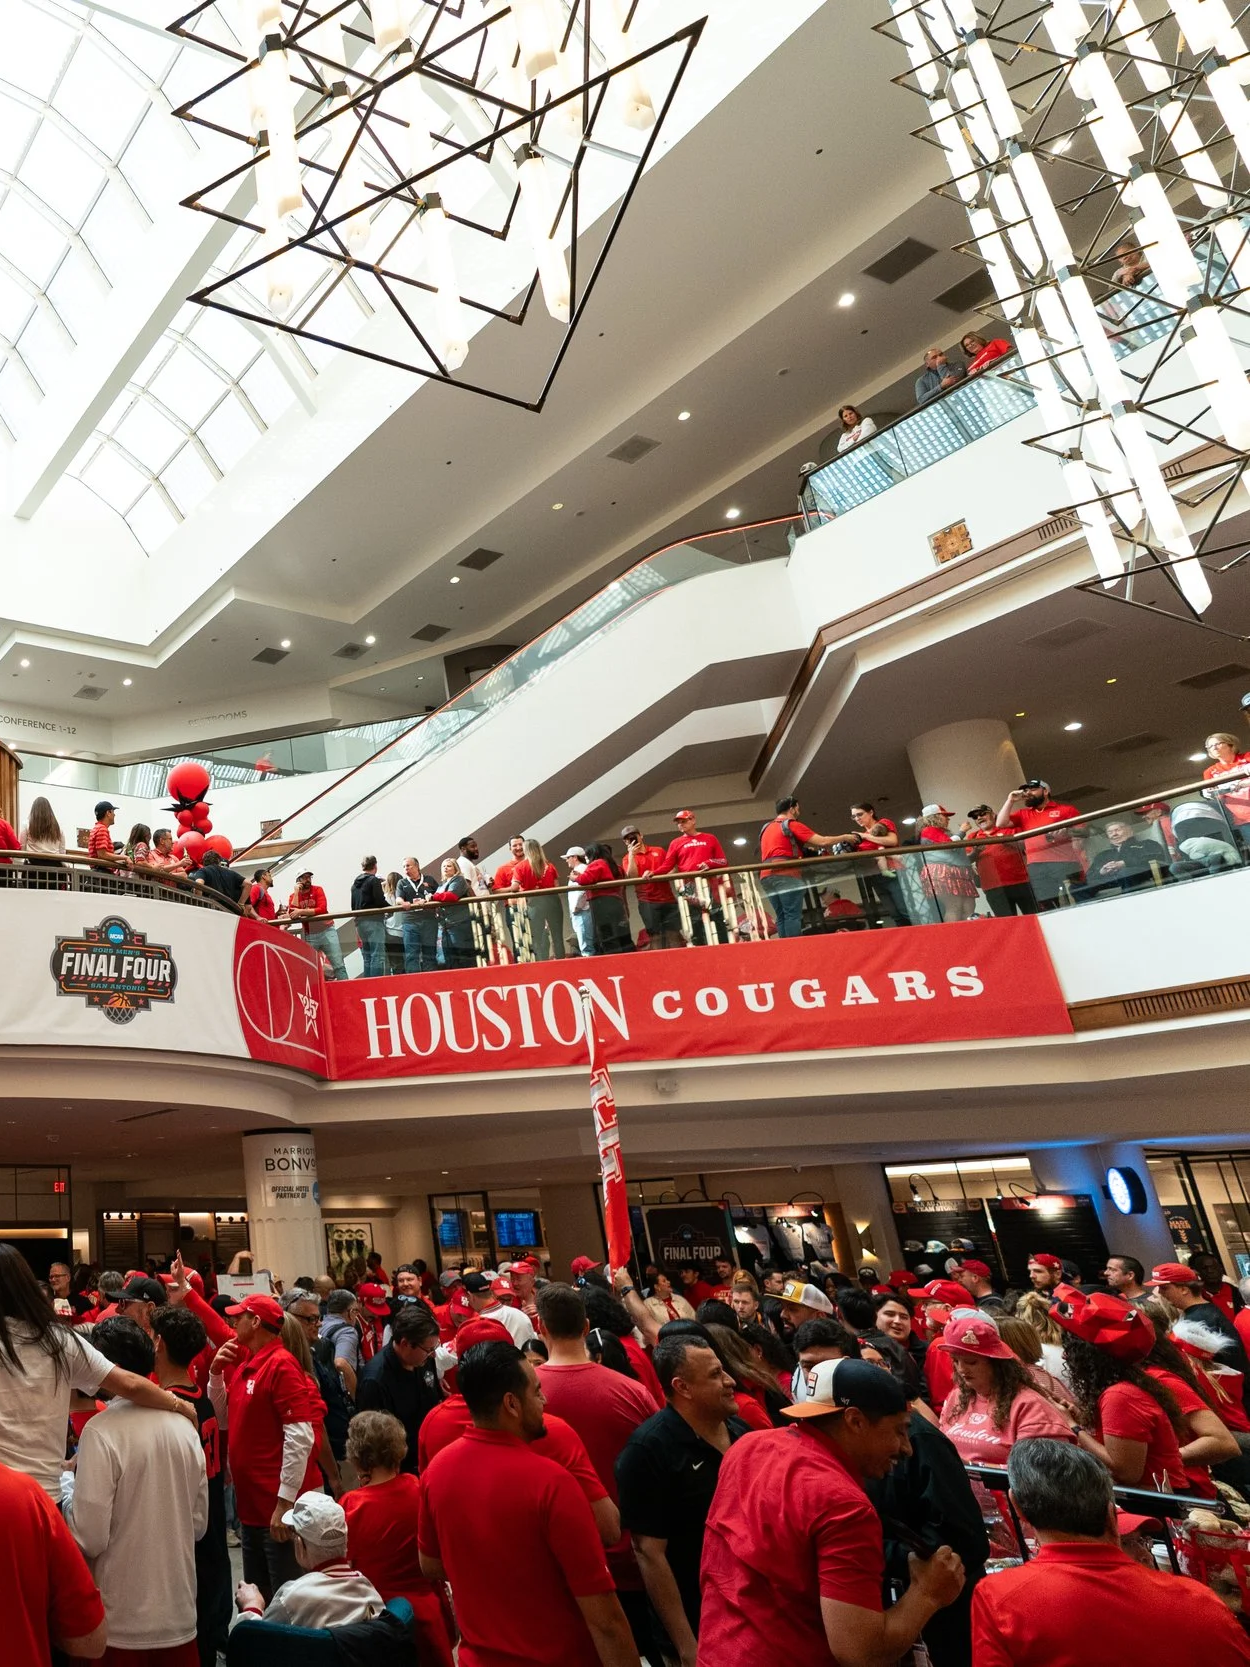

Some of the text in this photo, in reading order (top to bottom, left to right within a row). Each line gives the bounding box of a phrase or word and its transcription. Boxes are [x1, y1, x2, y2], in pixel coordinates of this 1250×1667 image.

[58, 724, 77, 735] 1-12
[60, 952, 172, 982] FINAL FOUR
[110, 984, 146, 992] ANTONIO
[302, 995, 319, 1020] 25
[360, 964, 985, 1060] HOUSTON COUGARS
[274, 1147, 314, 1155] MARRIOT
[265, 1158, 316, 1171] BONVO
[276, 1192, 300, 1200] PARTNER
[664, 1246, 722, 1260] FINAL FOUR
[946, 1422, 1002, 1445] Houston
